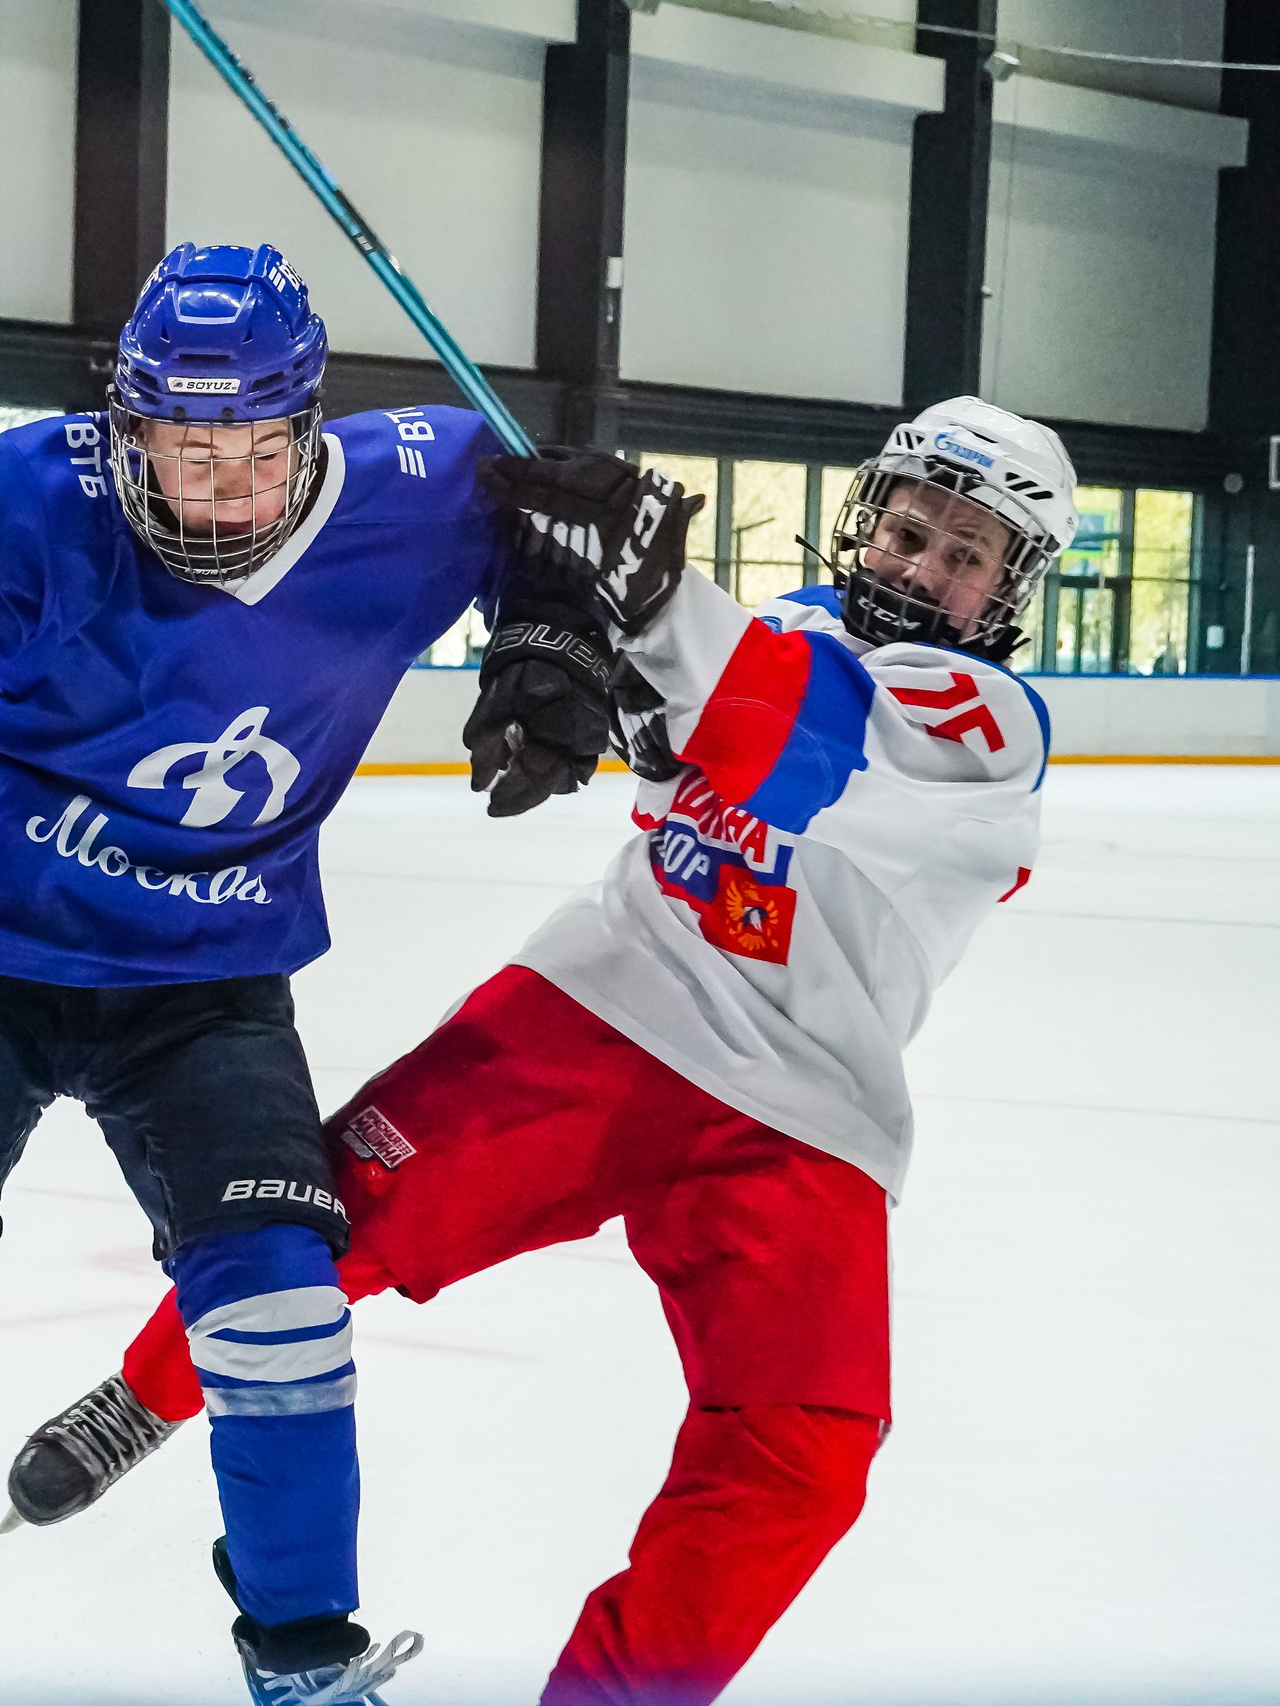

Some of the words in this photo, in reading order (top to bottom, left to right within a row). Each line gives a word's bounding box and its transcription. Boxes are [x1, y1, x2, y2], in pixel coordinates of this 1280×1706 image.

[186, 381, 232, 390] SOYUZ
[382, 407, 436, 441] ВТ
[25, 795, 272, 905] Москва
